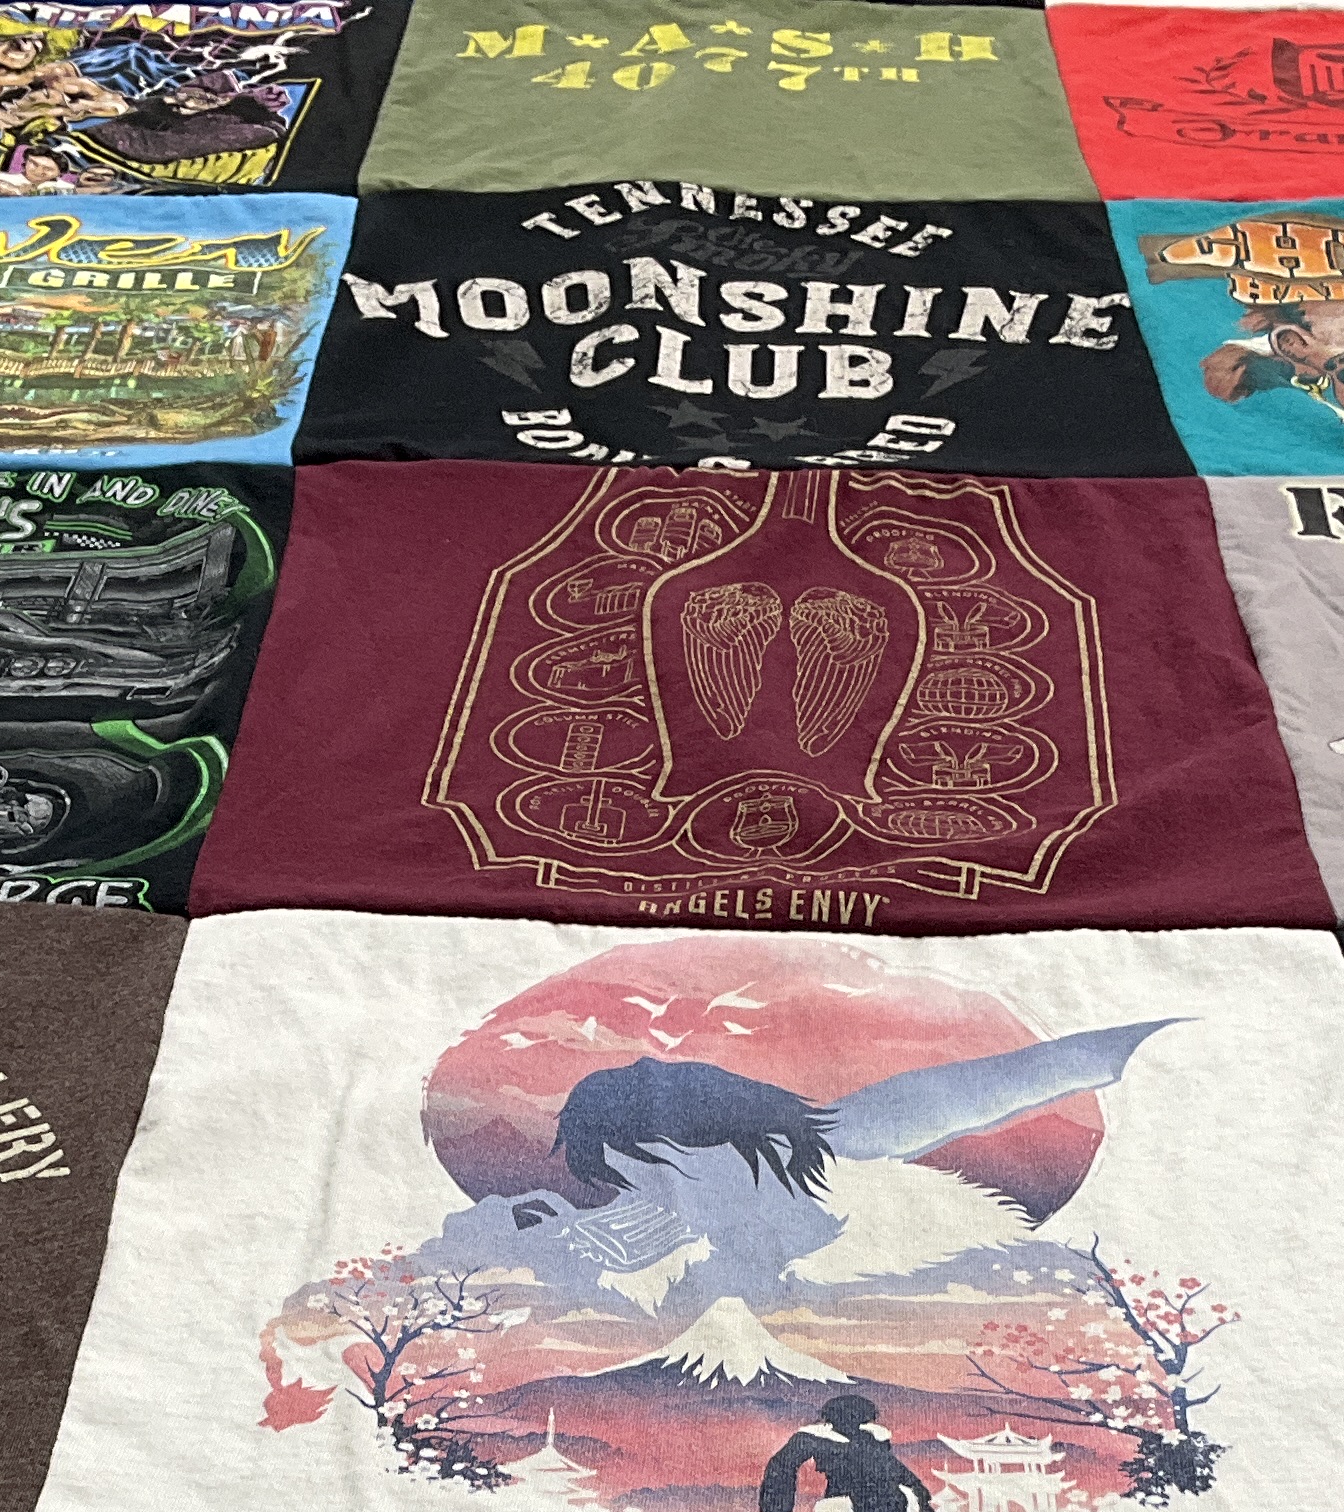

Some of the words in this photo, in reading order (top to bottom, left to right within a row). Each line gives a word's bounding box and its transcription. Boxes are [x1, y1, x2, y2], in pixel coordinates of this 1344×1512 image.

[522, 179, 955, 258] TENNESSEE
[26, 267, 240, 294] GRILLE
[342, 256, 1134, 351] MOONSHINE
[569, 324, 897, 401] CLUB
[28, 471, 74, 501] IN
[78, 476, 159, 507] AND
[923, 590, 999, 604] BLENDING
[532, 714, 599, 727] COLUMN
[919, 726, 1004, 742] BLENDING
[637, 887, 774, 920] ANGELS
[788, 888, 882, 928] ENVY
